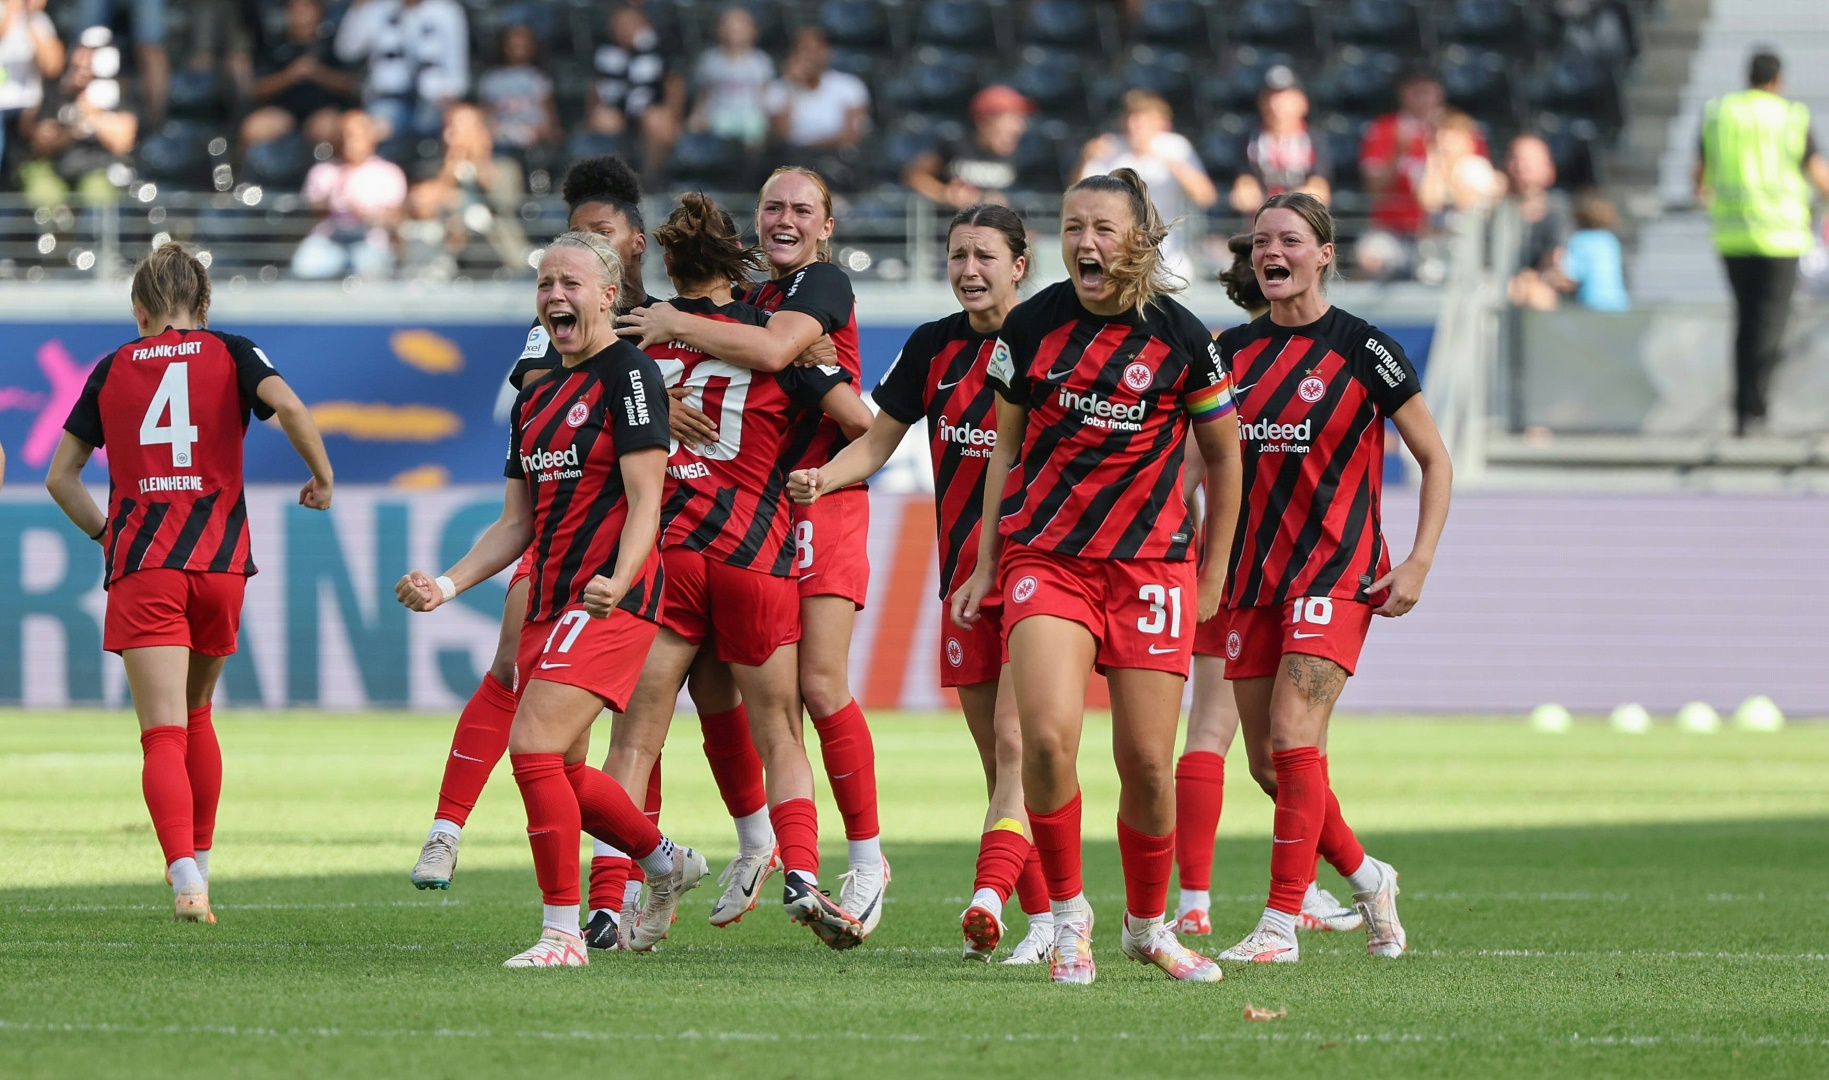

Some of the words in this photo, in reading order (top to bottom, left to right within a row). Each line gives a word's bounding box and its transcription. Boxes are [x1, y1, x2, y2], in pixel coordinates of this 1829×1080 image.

[132, 341, 202, 361] FRANKFURT
[524, 343, 541, 352] xel
[1365, 337, 1406, 383] ELOTRANS
[1374, 363, 1399, 389] reload
[623, 395, 639, 427] reload
[628, 369, 650, 426] ELOTRANS
[1057, 386, 1146, 421] indeed
[139, 361, 199, 468] 4
[1081, 415, 1106, 428] Jobs
[1107, 419, 1142, 431] finden
[1237, 415, 1311, 441] indeed
[938, 415, 998, 447] indee
[519, 443, 579, 474] indeed
[960, 446, 981, 458] Jobs
[1258, 443, 1280, 453] Jobs
[1280, 442, 1310, 453] finden
[138, 475, 203, 495] KLEINHERNE
[537, 472, 553, 483] Jobs
[553, 468, 582, 481] finden
[1137, 584, 1181, 638] 31
[1292, 596, 1333, 626] 18
